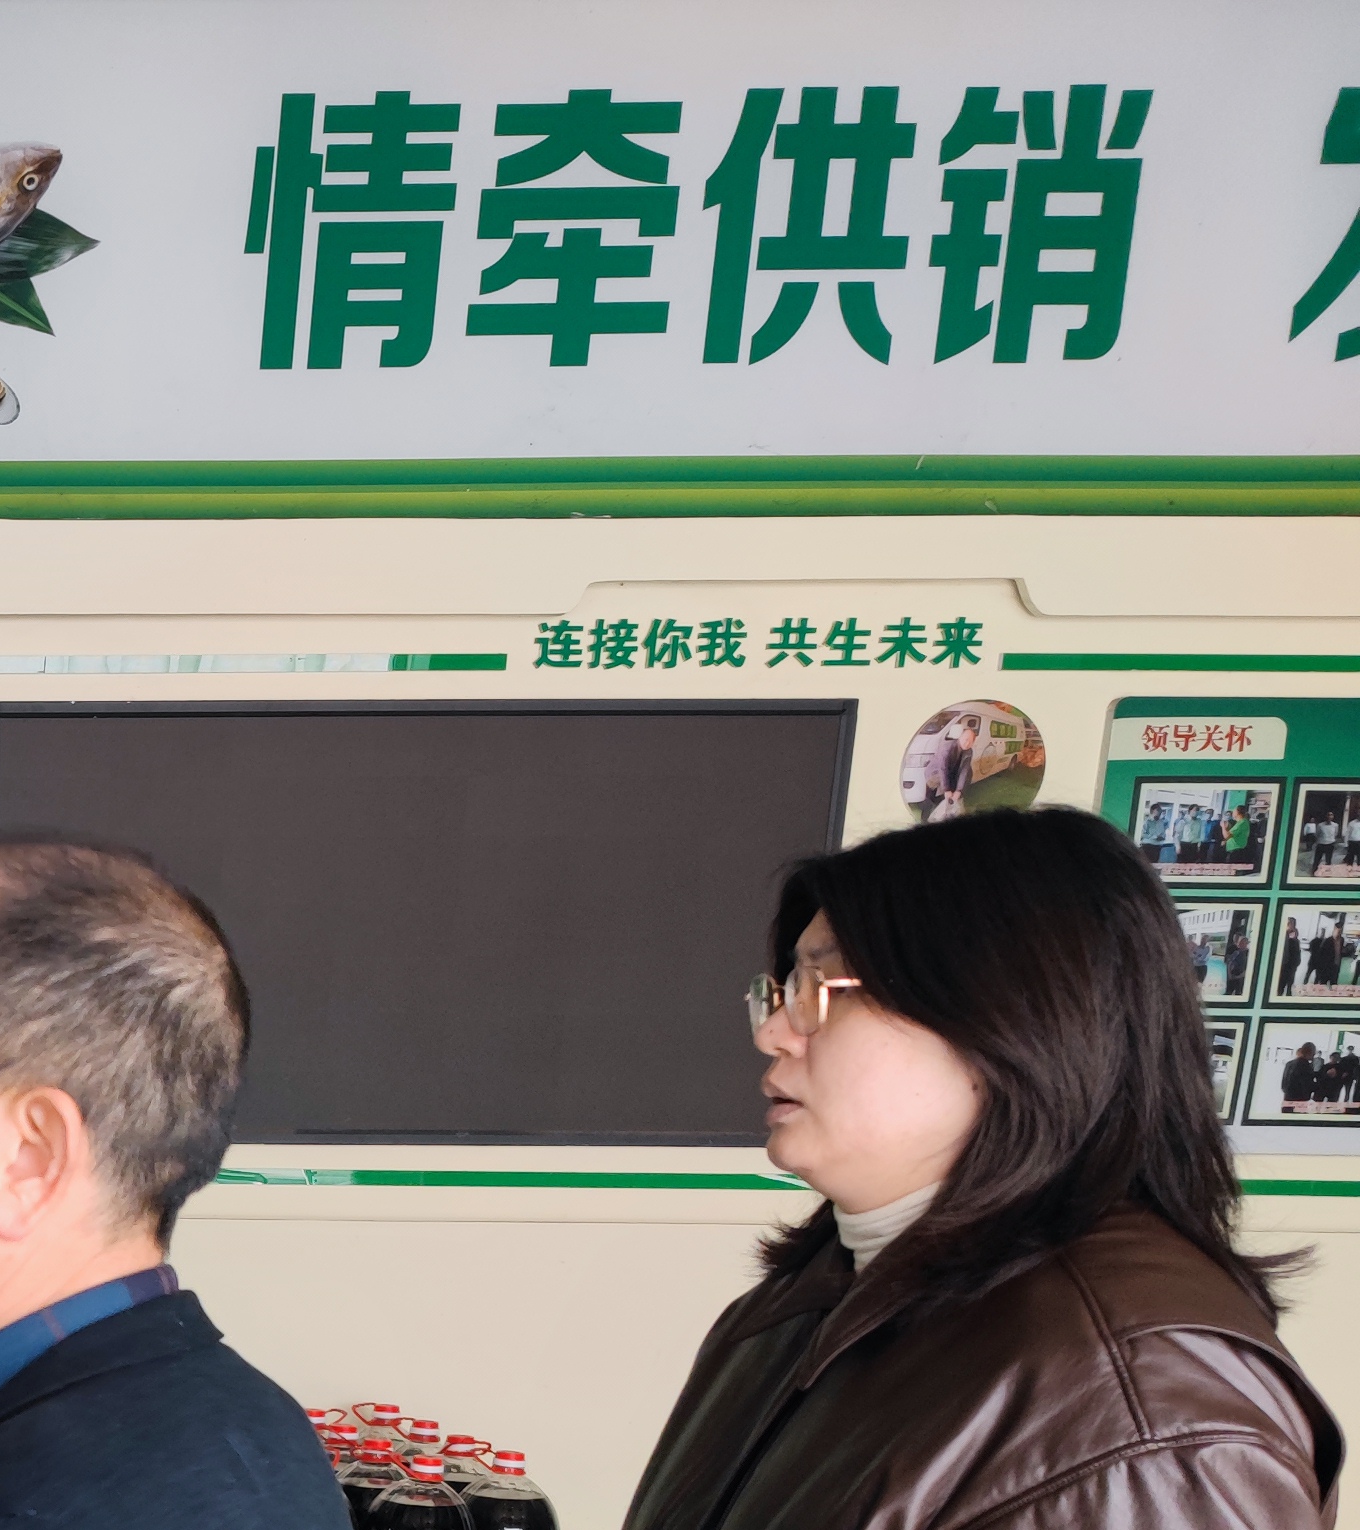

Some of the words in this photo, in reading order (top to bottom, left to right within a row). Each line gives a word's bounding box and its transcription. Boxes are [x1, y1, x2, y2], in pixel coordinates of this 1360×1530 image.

[243, 84, 1153, 371] 情牵供销
[532, 615, 748, 670] 连接你我
[764, 615, 984, 670] 共生未来
[1141, 723, 1254, 753] 领导关怀
